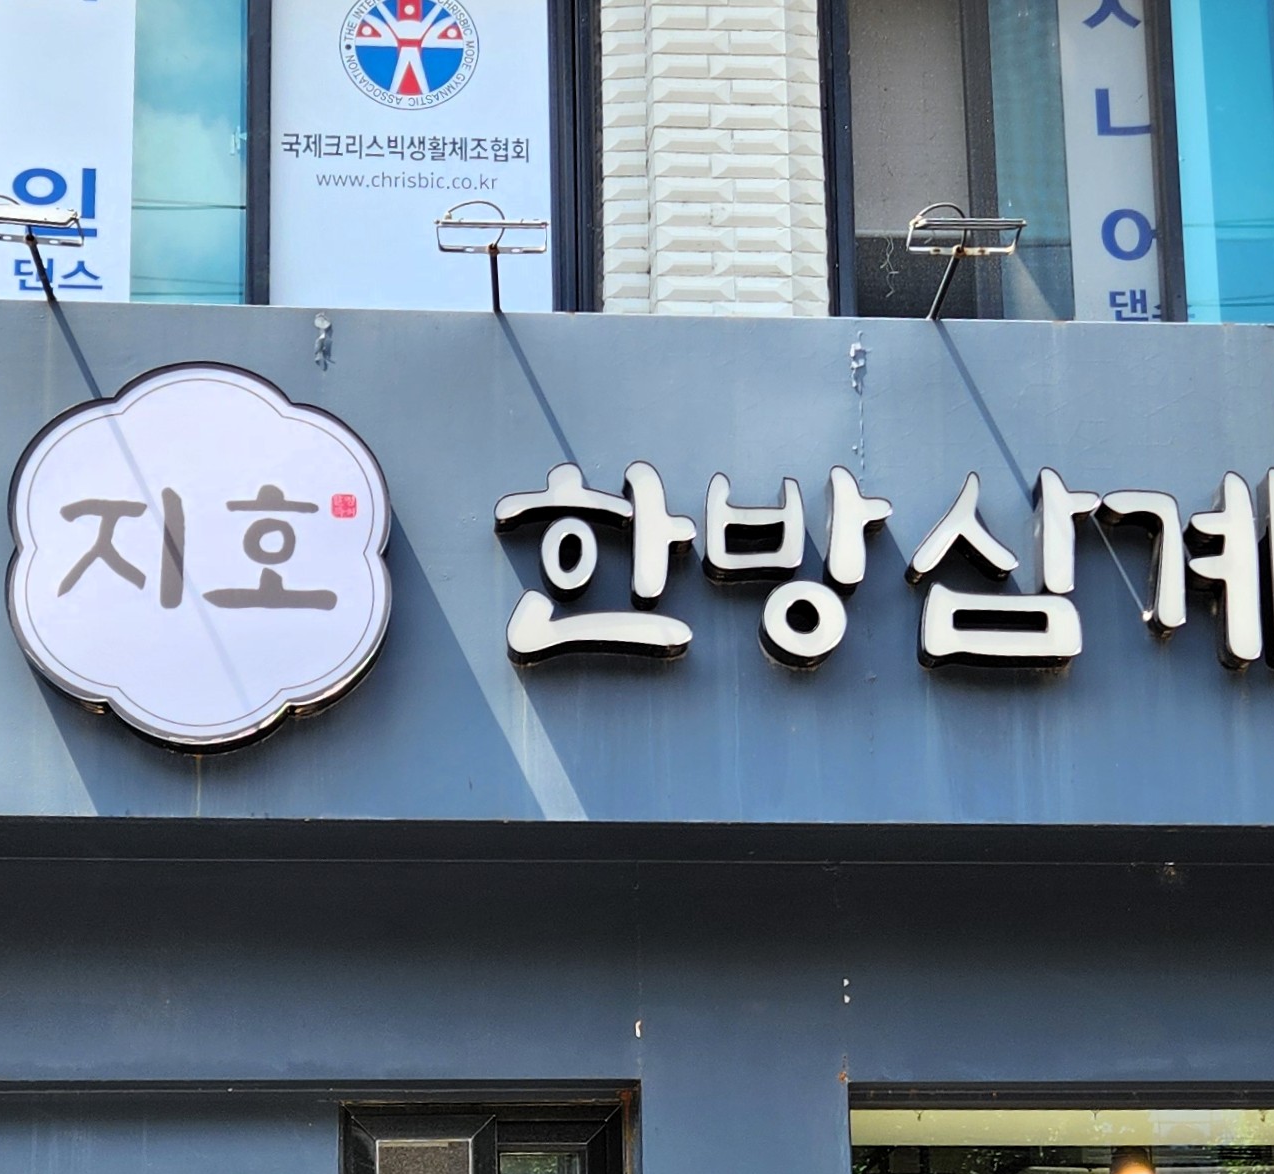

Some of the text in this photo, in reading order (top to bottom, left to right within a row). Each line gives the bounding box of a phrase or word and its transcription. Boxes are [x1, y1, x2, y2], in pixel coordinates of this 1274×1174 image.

[281, 133, 531, 163] 국제크리스빅생활체조협회
[316, 172, 498, 190] www.chrisbic.co.kr
[13, 258, 103, 291] 댄스
[57, 484, 338, 611] 지호
